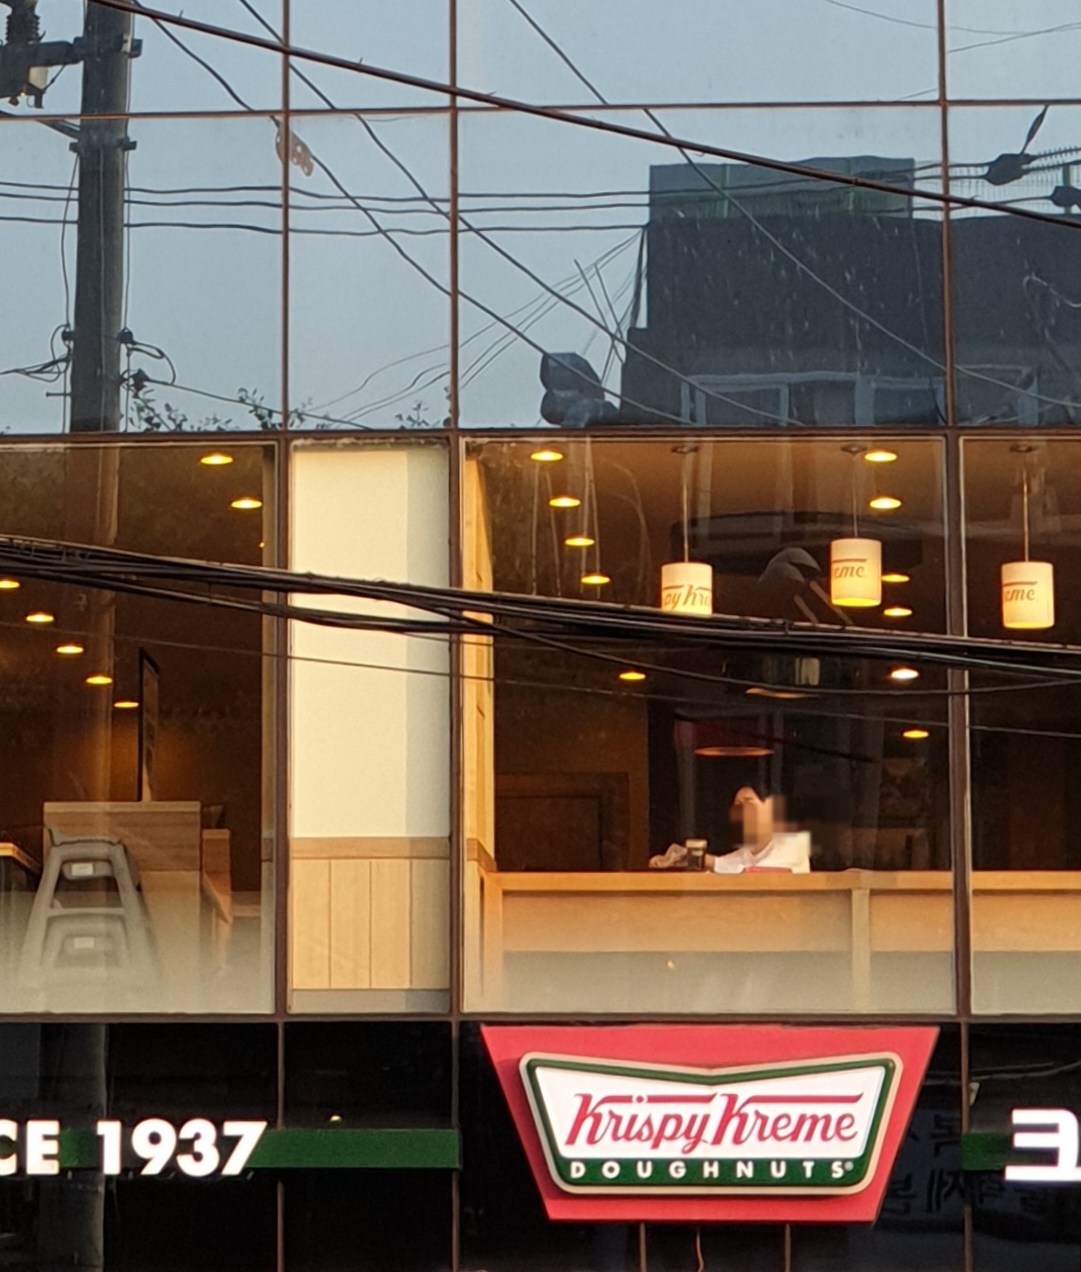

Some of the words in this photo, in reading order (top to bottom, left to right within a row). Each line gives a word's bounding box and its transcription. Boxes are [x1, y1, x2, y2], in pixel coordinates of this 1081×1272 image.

[97, 1119, 267, 1177] 1937
[565, 1092, 718, 1154] Krispy
[710, 1092, 864, 1146] Kreme
[569, 1160, 845, 1180] DOUGHNUTS
